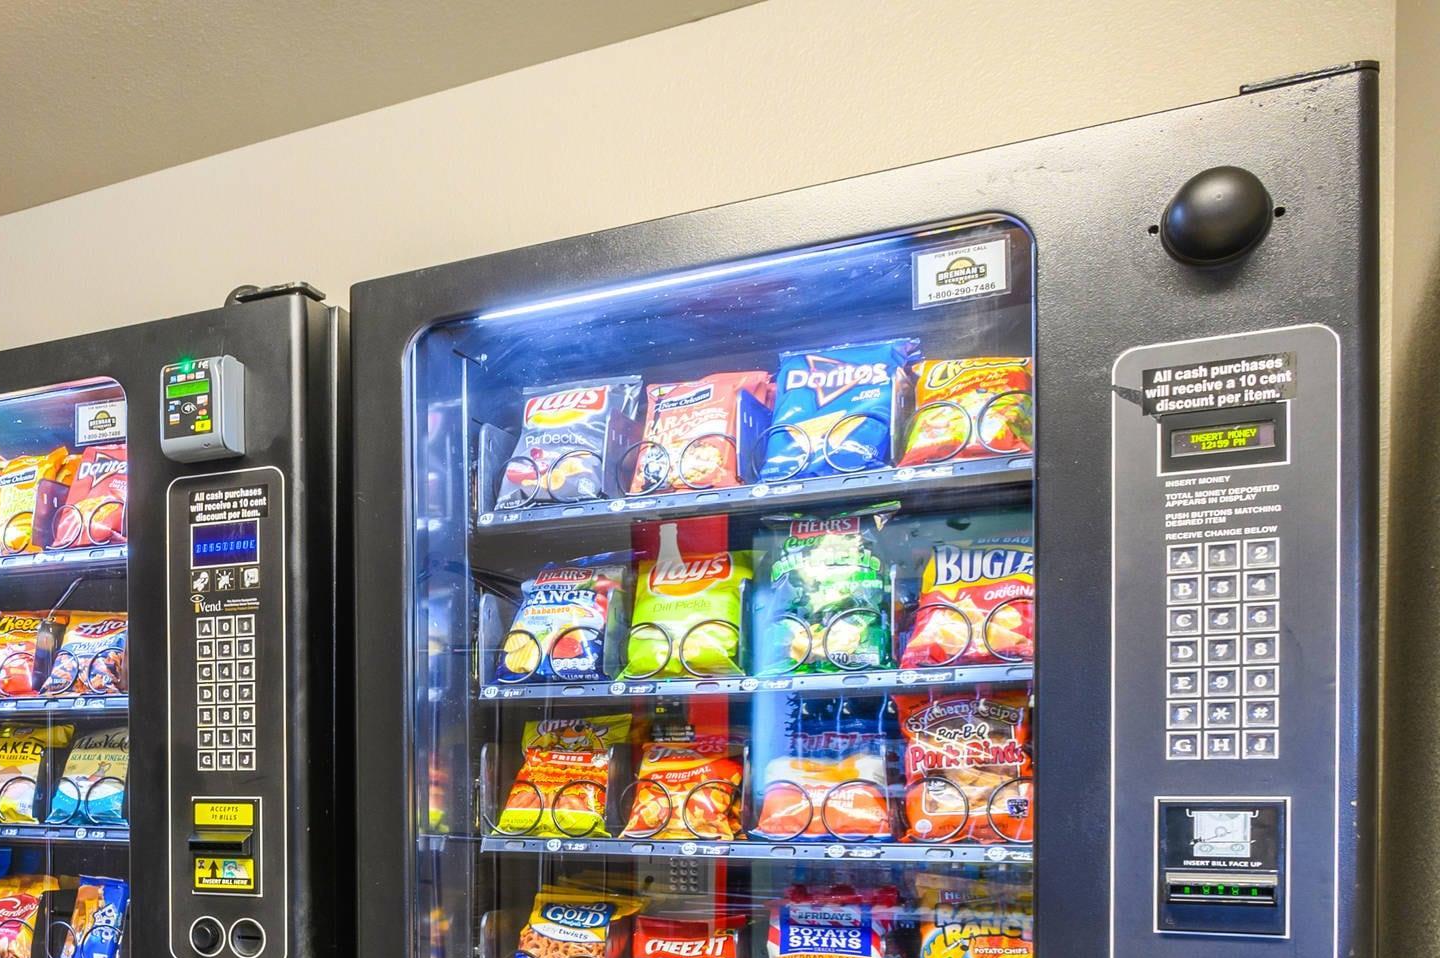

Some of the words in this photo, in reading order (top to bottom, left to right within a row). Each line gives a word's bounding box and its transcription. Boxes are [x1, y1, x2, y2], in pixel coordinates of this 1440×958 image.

[928, 282, 996, 300] 1-800-290-7486
[787, 363, 890, 390] Doritos
[1153, 370, 1171, 383] All
[1175, 366, 1208, 380] cash
[1211, 357, 1283, 378] purchases
[1145, 384, 1170, 398] will
[1172, 379, 1222, 396] receive
[1226, 379, 1236, 389] a
[1239, 374, 1257, 386] 10
[1260, 371, 1292, 384] cent
[662, 402, 678, 411] New
[679, 392, 712, 405] Orleans
[1156, 395, 1214, 412] discount
[1217, 394, 1241, 407] per
[1244, 388, 1280, 402] item.
[1191, 431, 1223, 443] INSERT
[1227, 428, 1257, 439] MONEY
[1233, 437, 1247, 446] PM
[1165, 478, 1197, 487] INSERT
[1199, 475, 1231, 484] MONEY
[195, 492, 204, 501] All
[206, 491, 223, 500] cash
[225, 488, 262, 500] purchases
[1165, 491, 1193, 500] TOTAL
[1195, 488, 1227, 498] MONEY
[1229, 484, 1280, 495] DEPOSITED
[190, 503, 203, 512] will
[205, 501, 231, 511] receive
[240, 499, 248, 507] 10
[250, 497, 266, 506] cent
[1165, 498, 1207, 508] APPEARS
[1220, 494, 1257, 503] DISPLAY
[196, 512, 227, 521] discount
[228, 511, 240, 520] per
[242, 509, 260, 518] item.
[1165, 512, 1190, 521] PUSH
[1191, 508, 1233, 518] BUTTONS
[1235, 504, 1282, 515] MATCHING
[798, 518, 852, 533] HERR'S
[1165, 518, 1203, 528] DESIRED
[1205, 517, 1226, 525] ITEM
[1165, 531, 1202, 541] RECEIVE
[1204, 529, 1242, 538] CHANGE
[1244, 526, 1278, 534] BELOW
[1176, 552, 1192, 565] A
[1218, 550, 1226, 562] 1
[1255, 546, 1268, 560] 2
[542, 568, 587, 581] HERR'S
[1178, 583, 1192, 596] B
[1253, 579, 1266, 591] 4
[1176, 614, 1192, 627] C
[1256, 610, 1267, 623] 6
[202, 623, 210, 632] A
[243, 621, 249, 631] 1
[203, 645, 211, 655] B
[223, 645, 230, 654] 2
[1178, 645, 1193, 658] D
[1255, 643, 1267, 655] 8
[223, 667, 230, 676] 4
[1178, 677, 1192, 689] E
[1217, 676, 1228, 688] 9
[1255, 675, 1267, 687] 0
[203, 690, 211, 699] D
[223, 689, 230, 698] 6
[243, 689, 250, 698] 7
[203, 711, 211, 721] E
[223, 711, 230, 721] 8
[243, 711, 250, 720] 9
[906, 702, 969, 732] Southern
[1178, 708, 1192, 720] F
[203, 733, 210, 742] F
[223, 733, 230, 742] L
[242, 733, 251, 742] N
[937, 723, 988, 742] Bar-B-Q
[1176, 739, 1191, 751] G
[1213, 739, 1229, 751] H
[1255, 738, 1267, 751] J
[203, 756, 211, 765] G
[222, 756, 231, 765] H
[243, 755, 250, 765] J
[551, 753, 585, 763] FRIES
[911, 747, 959, 770] Pork
[968, 741, 1024, 767] Rinds
[665, 766, 712, 780] ORIGINAL
[546, 906, 604, 927] GOLD
[804, 911, 852, 921] FRIDAYS
[559, 929, 589, 940] twists
[789, 926, 861, 938] POTATO
[788, 935, 862, 949] SKINS
